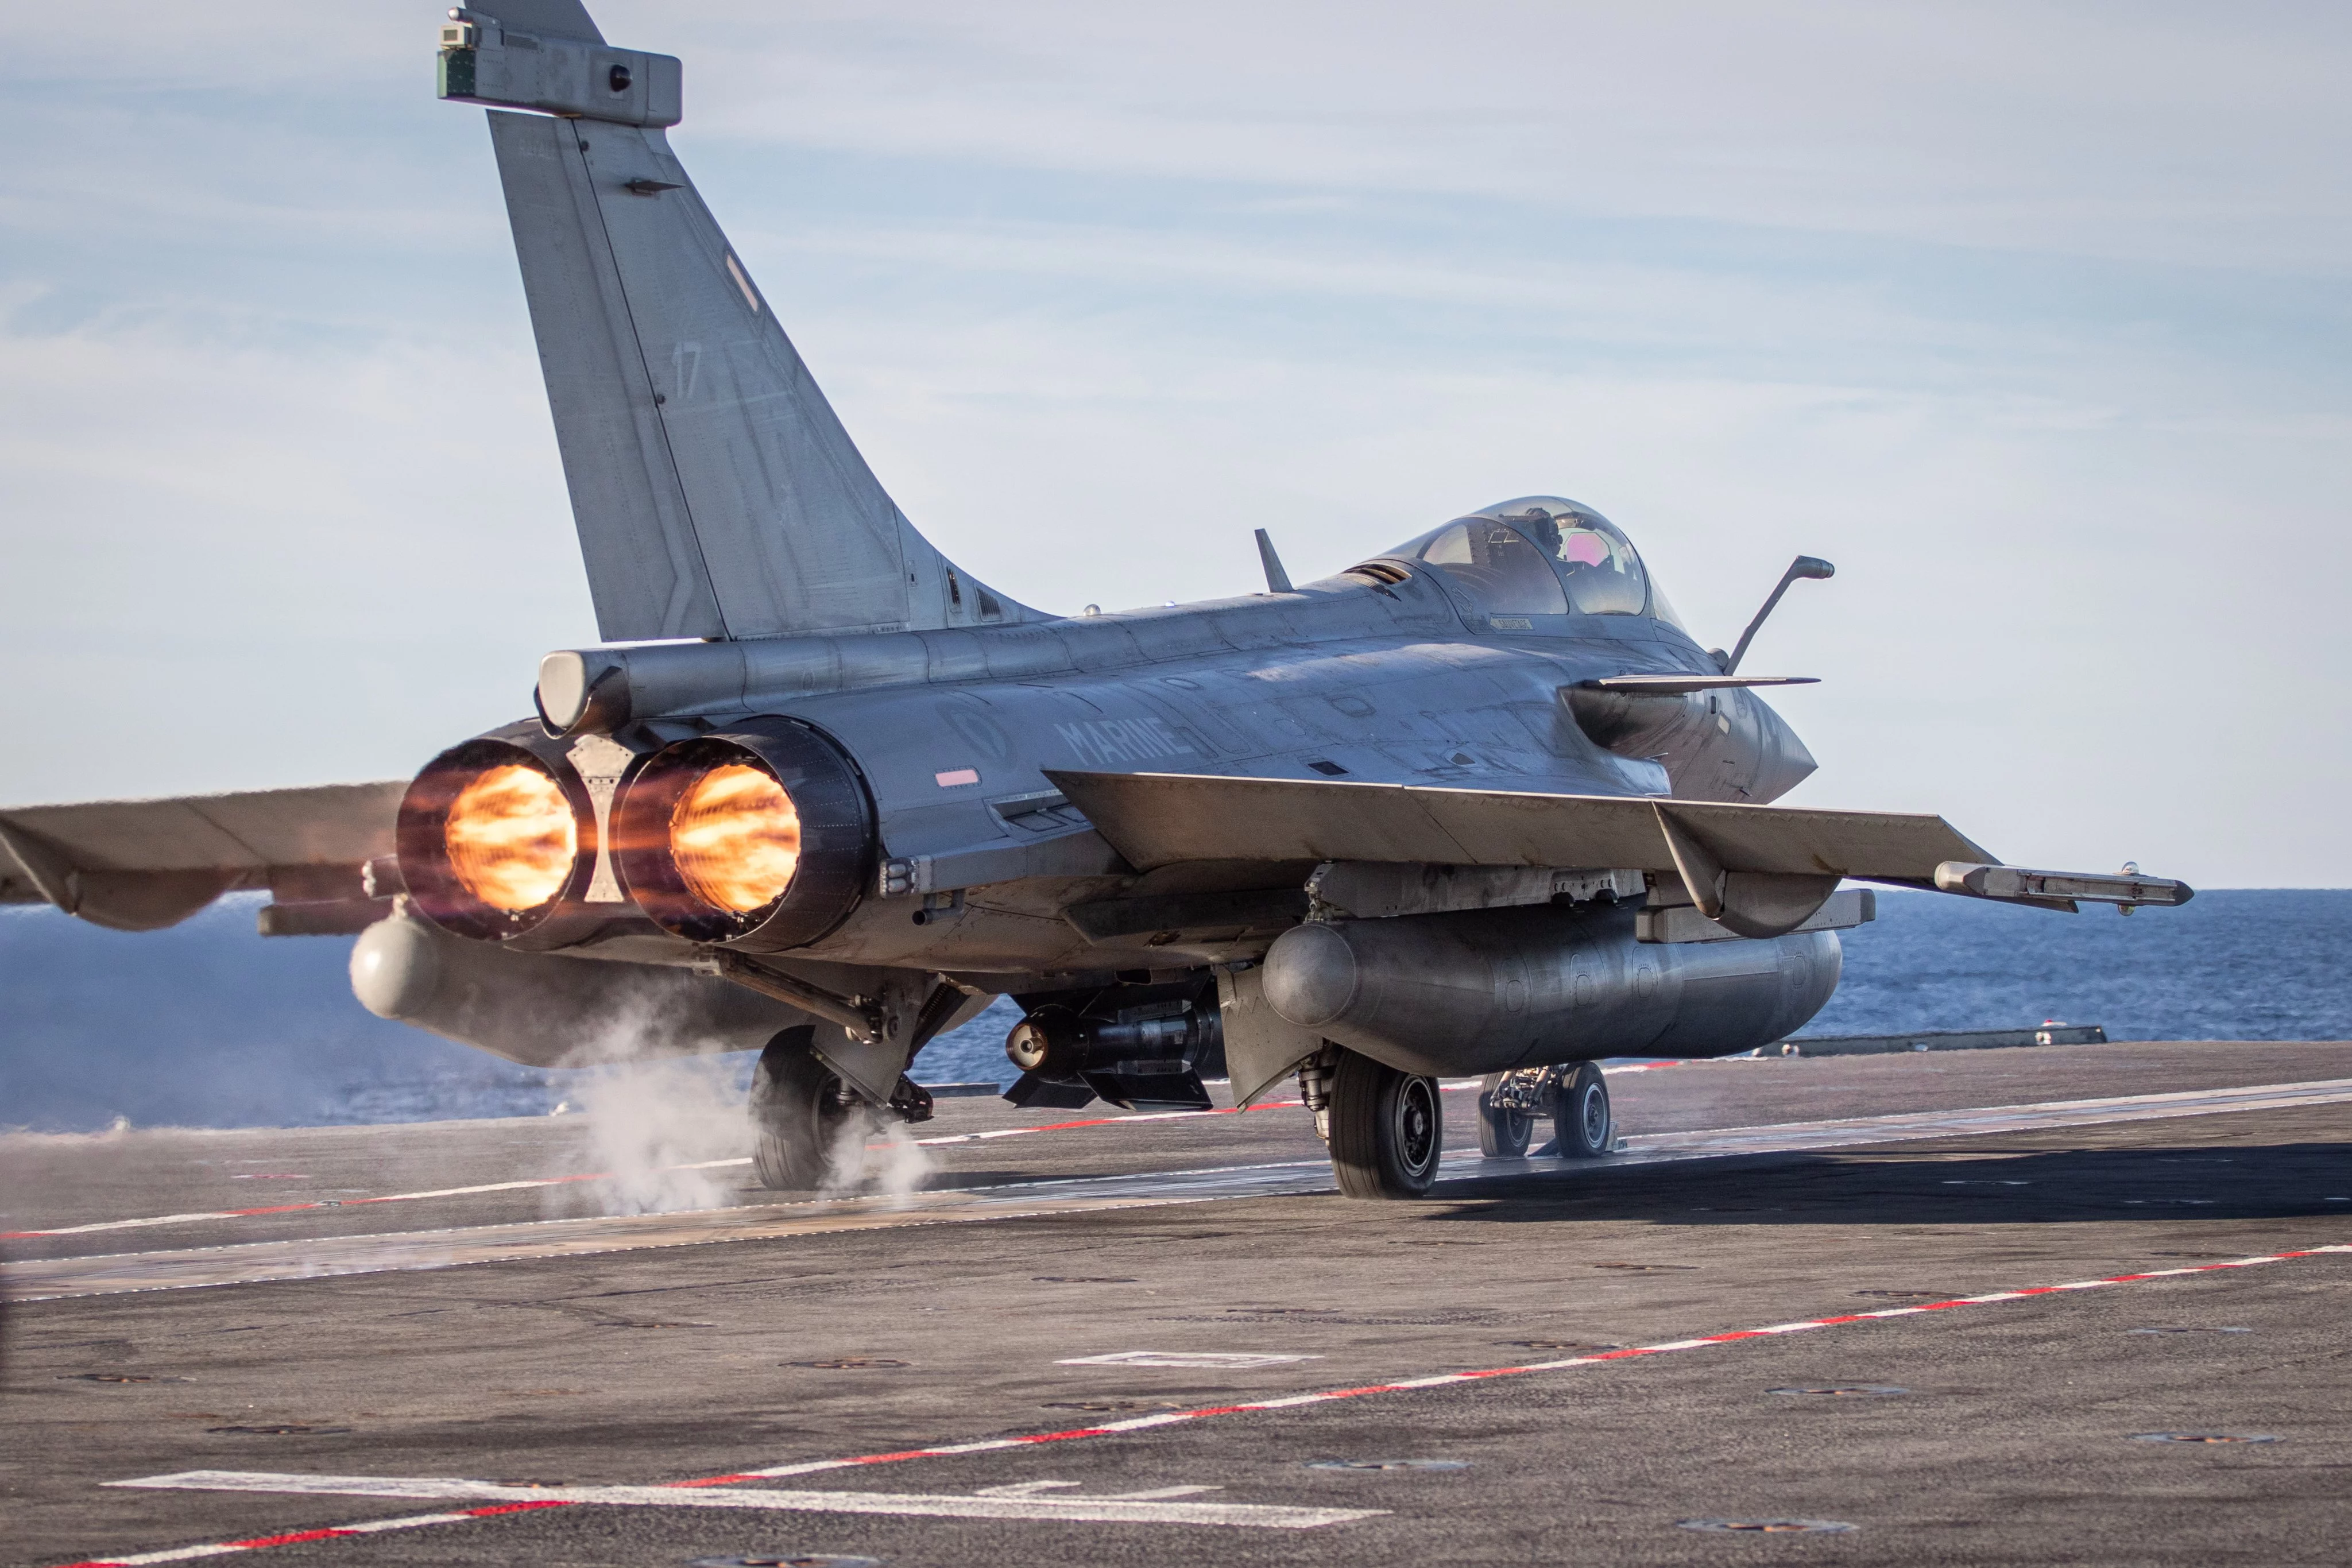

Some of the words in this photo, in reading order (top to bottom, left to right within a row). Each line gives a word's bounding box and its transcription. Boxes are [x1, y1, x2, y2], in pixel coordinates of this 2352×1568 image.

[671, 341, 702, 398] 17
[1498, 619, 1530, 629] SAUVETAGE
[1053, 717, 1195, 766] MARINE
